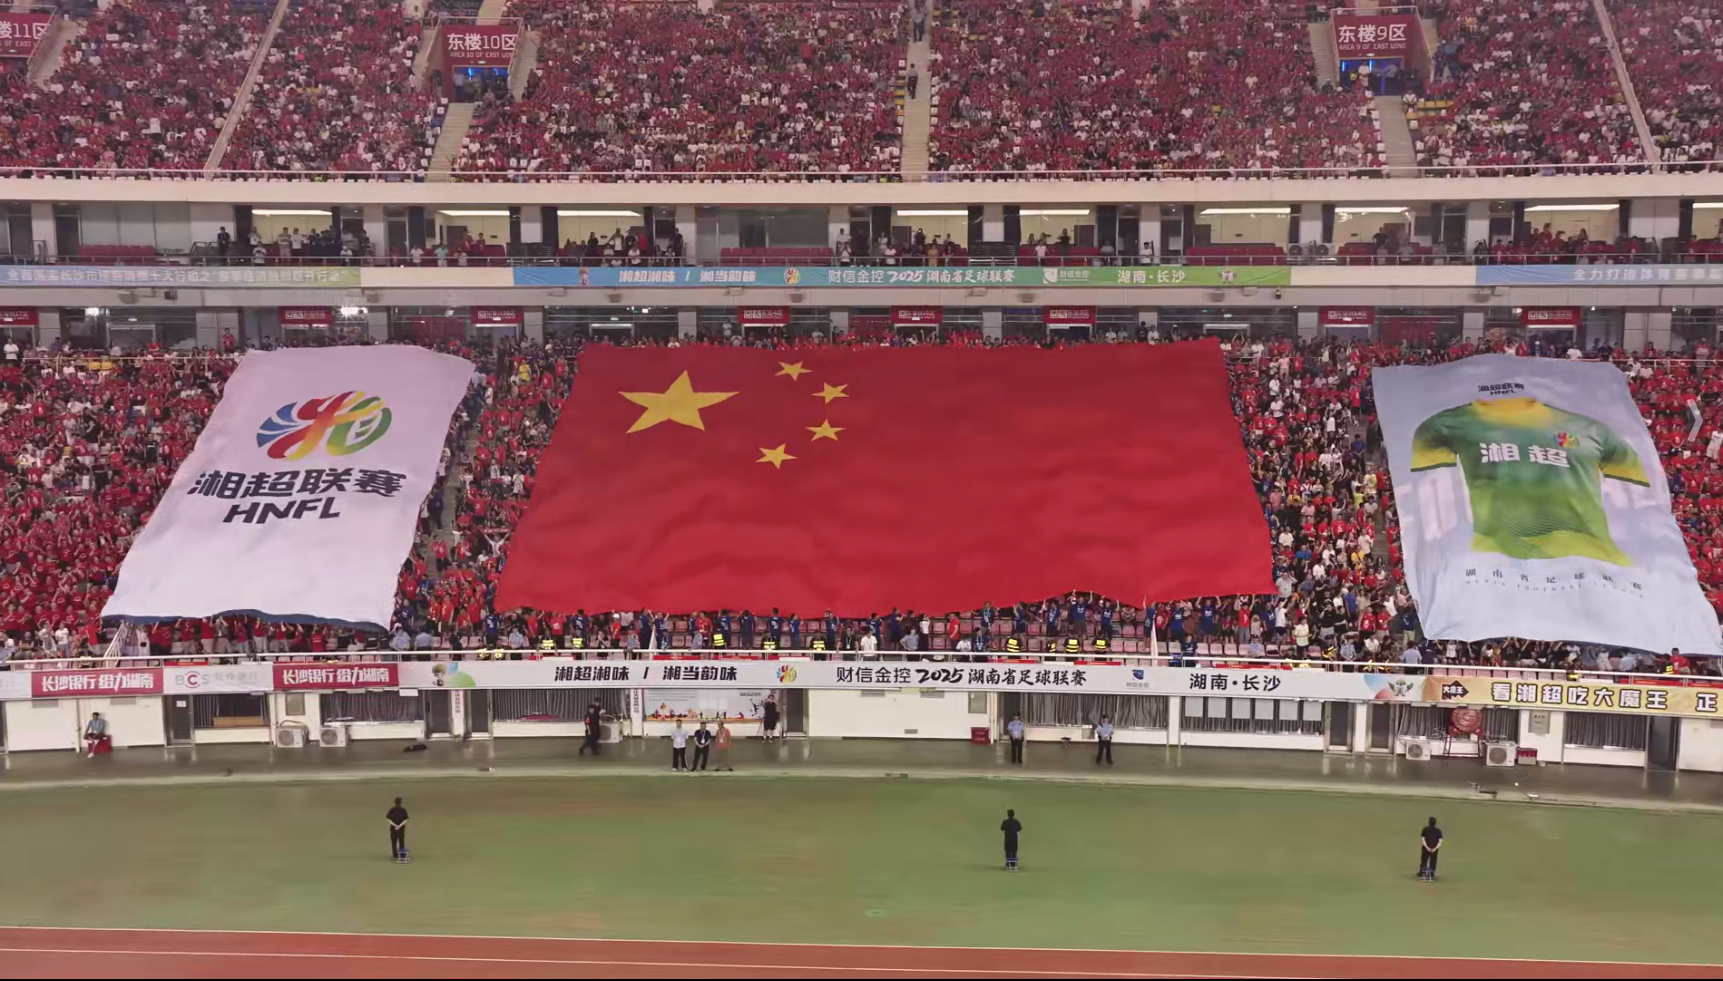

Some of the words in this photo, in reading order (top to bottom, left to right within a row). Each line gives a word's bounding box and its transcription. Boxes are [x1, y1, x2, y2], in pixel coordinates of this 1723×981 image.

[447, 33, 518, 50] 东楼10区
[1338, 24, 1407, 42] 东楼9区
[828, 269, 884, 283] 财信金控
[887, 270, 926, 283] 2025
[927, 269, 1016, 283] 湖南省足球联赛
[1117, 270, 1186, 283] 湖南·长沙
[187, 468, 407, 499] 湘超联赛
[222, 498, 340, 524] HNFL
[42, 674, 98, 692] 长沙银行
[98, 671, 154, 692] 给力湖南
[175, 673, 210, 686] BCS
[282, 668, 335, 685] 长沙银行
[336, 666, 390, 686] 给力湖南
[554, 666, 630, 682] 湘超湘味
[662, 665, 738, 681] 湘当韵味
[836, 667, 911, 684] 财信金控
[915, 667, 965, 684] 2025
[968, 668, 1087, 686] 湖南省足球联赛
[1189, 673, 1282, 692] 湖南·长沙
[1442, 685, 1464, 695] 大魔王
[1491, 682, 1668, 710] 看湘超吃大魔王
[1695, 692, 1718, 712] 正
